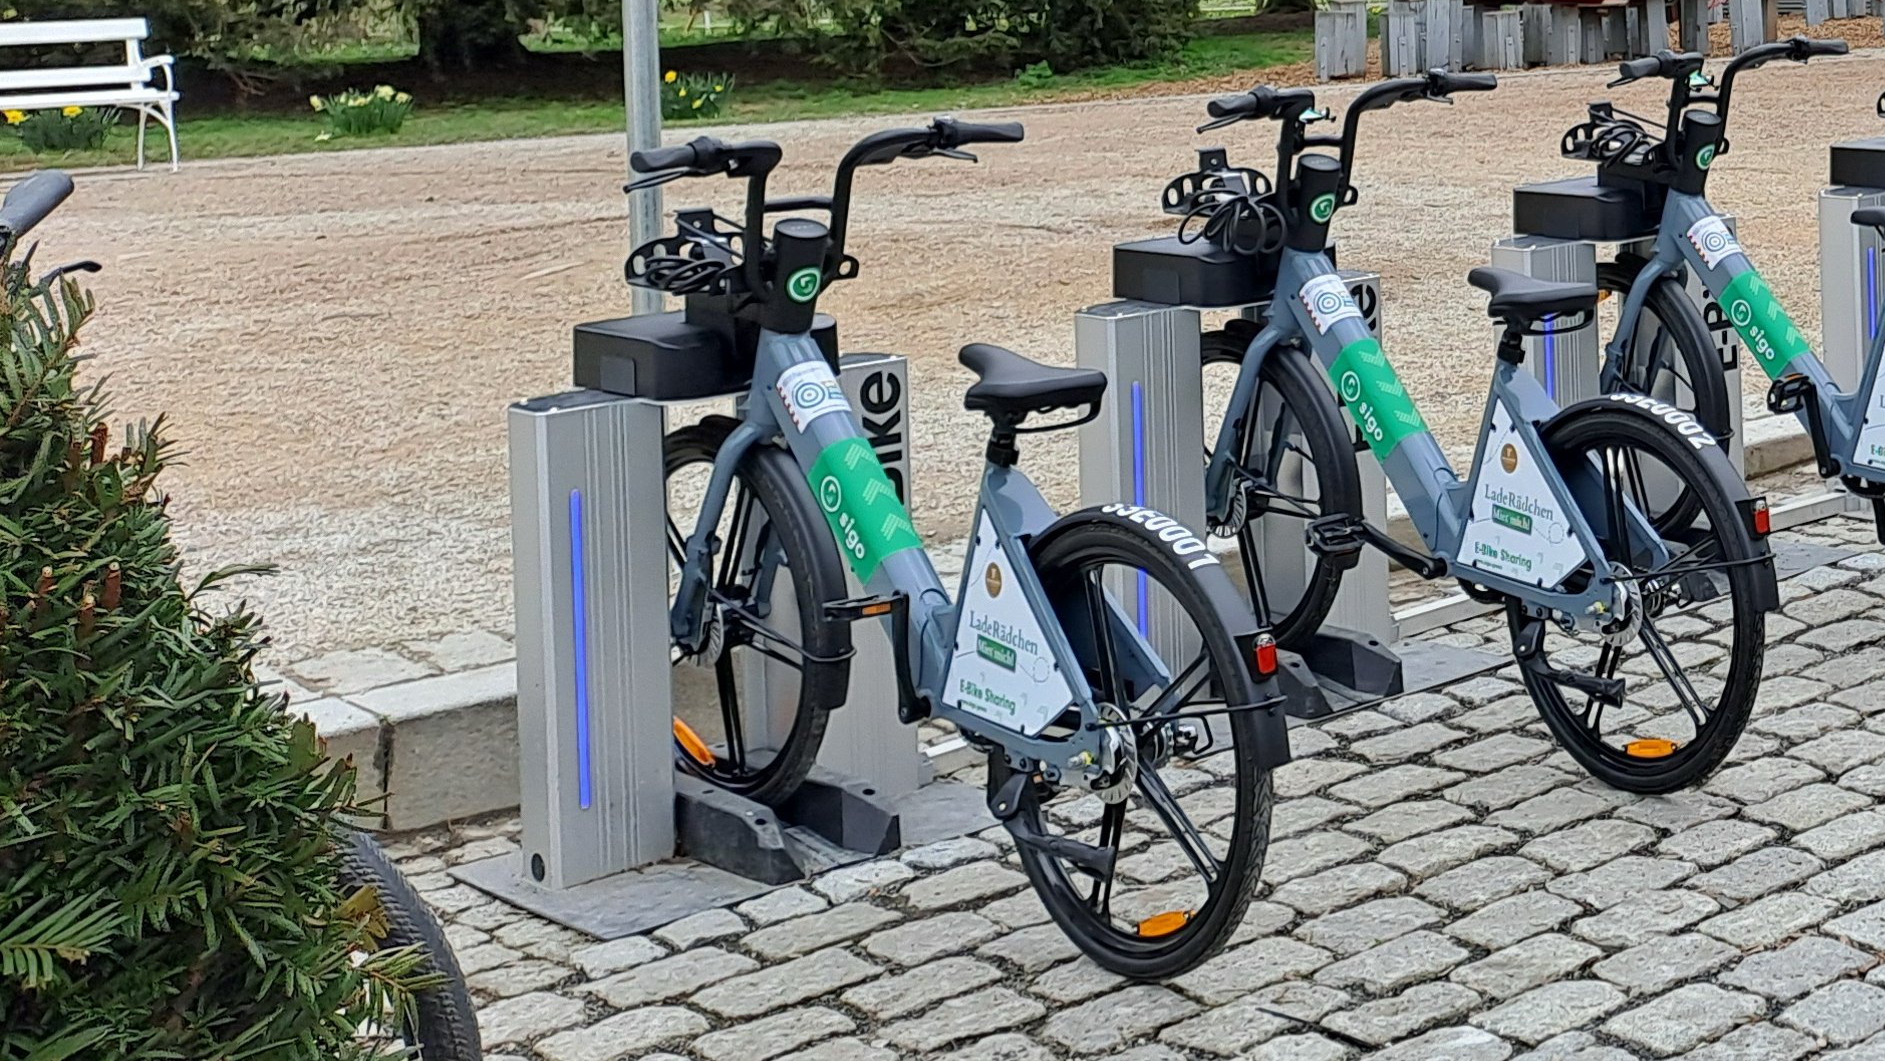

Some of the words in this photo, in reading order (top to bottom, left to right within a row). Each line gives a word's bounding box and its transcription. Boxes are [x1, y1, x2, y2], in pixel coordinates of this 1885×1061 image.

[1749, 325, 1776, 360] sigo
[1358, 400, 1384, 442] sigo
[1484, 483, 1554, 521] LadeRädchen
[838, 511, 866, 560] sigo
[1474, 541, 1498, 559] E-Bike
[1500, 548, 1533, 573] Sharing
[968, 609, 1039, 656] LadeRädchen
[960, 679, 983, 701] E-Bike
[984, 687, 1017, 717] Sharing
